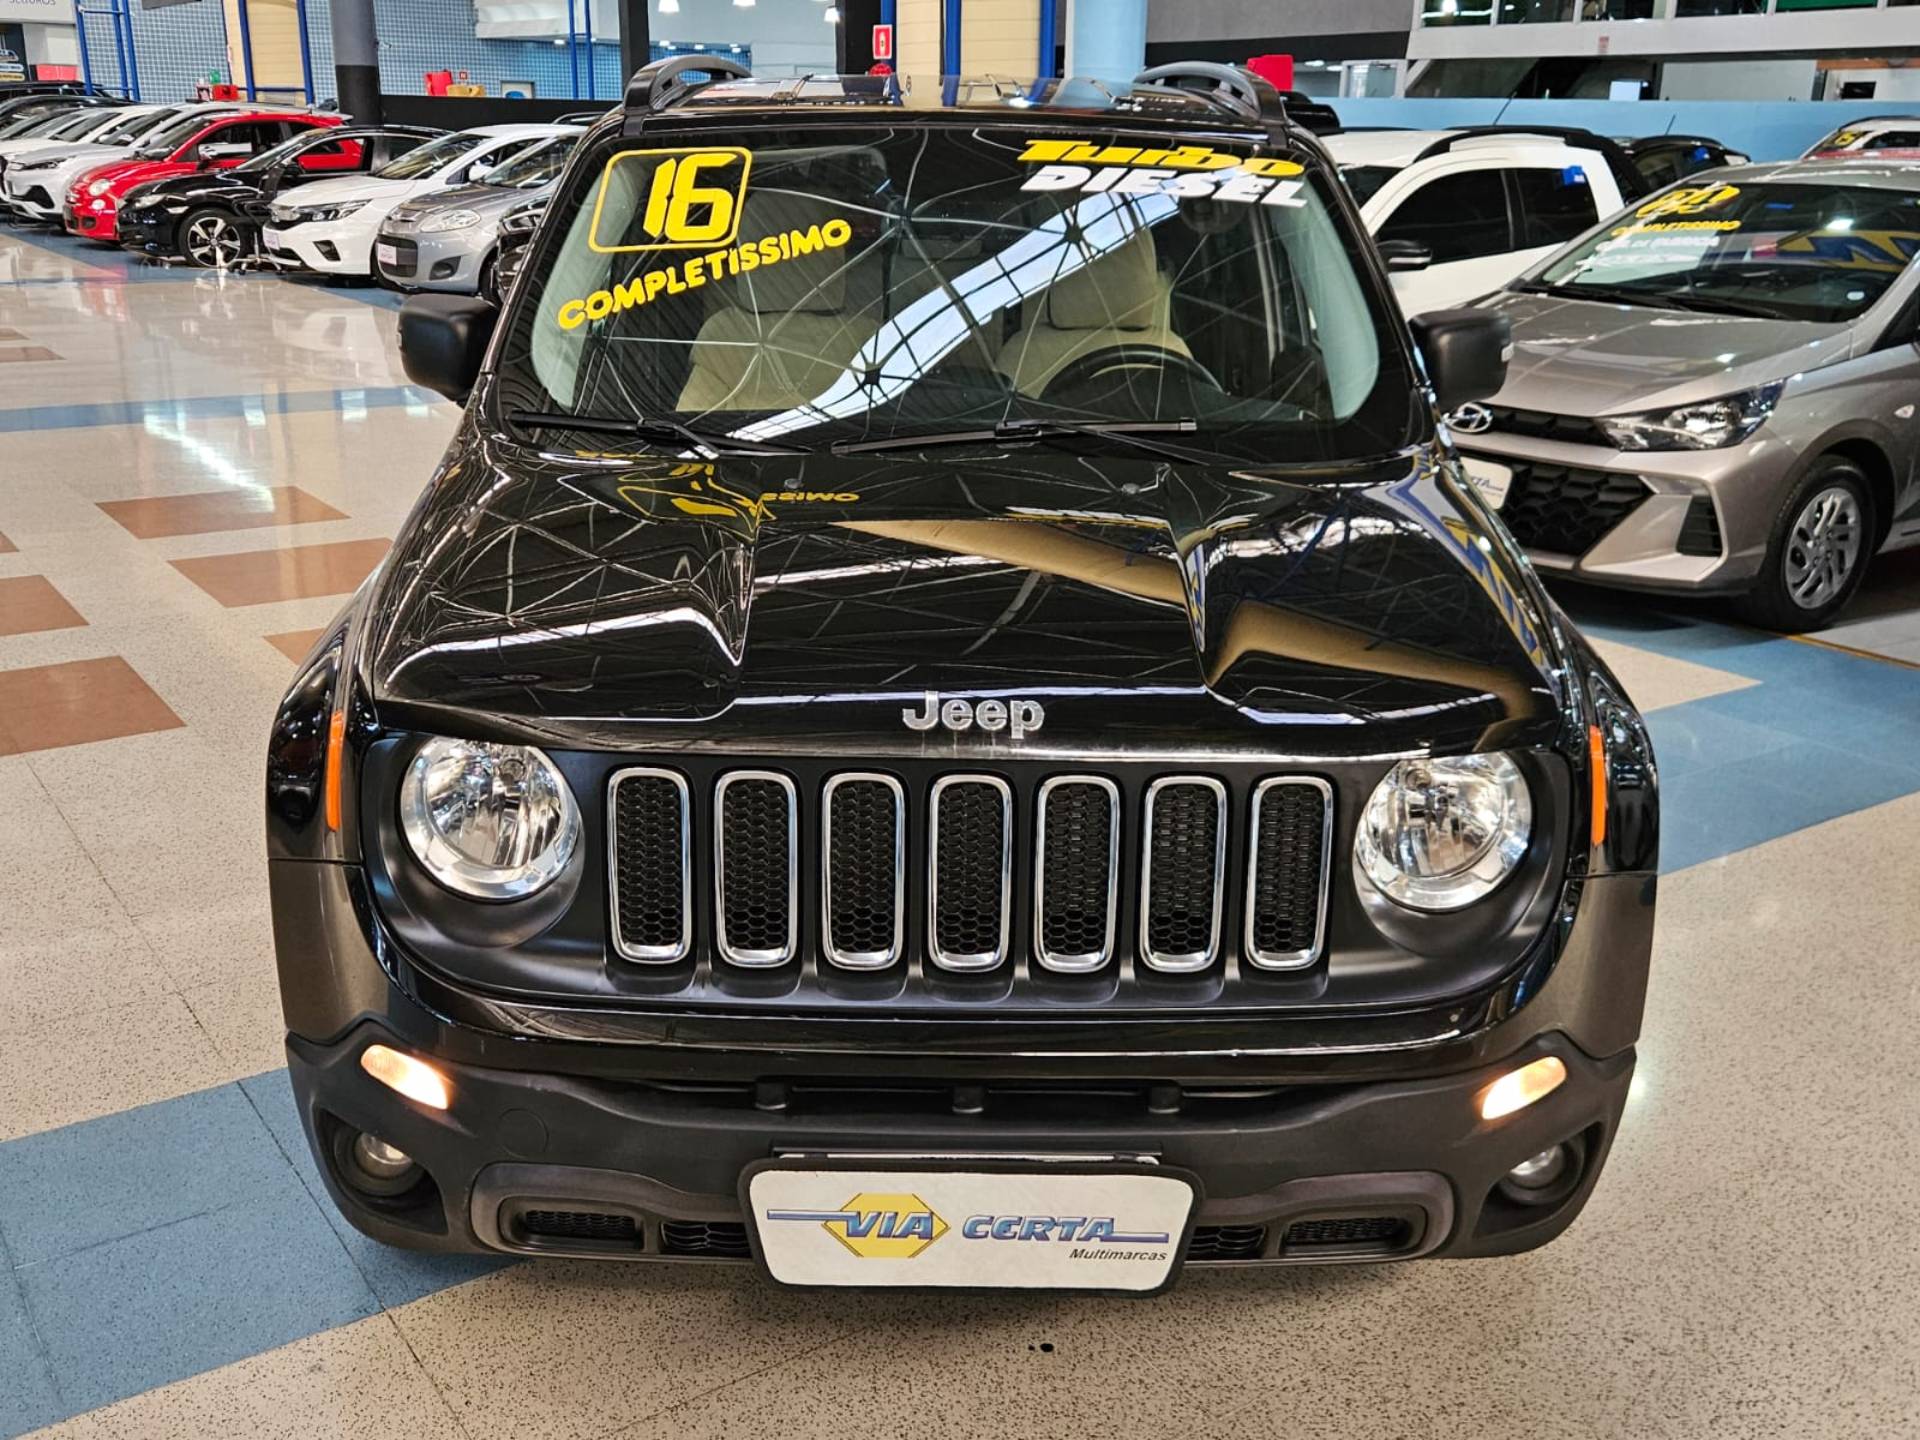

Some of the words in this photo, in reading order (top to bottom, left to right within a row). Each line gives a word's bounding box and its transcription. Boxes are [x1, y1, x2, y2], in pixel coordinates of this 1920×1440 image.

[642, 152, 738, 242] 16
[1020, 164, 1307, 208] DIESEL
[902, 690, 1045, 740] Jeep
[842, 1209, 935, 1241] VIA
[961, 1215, 1117, 1243] CERTA
[1068, 1246, 1169, 1262] Multimarcas
